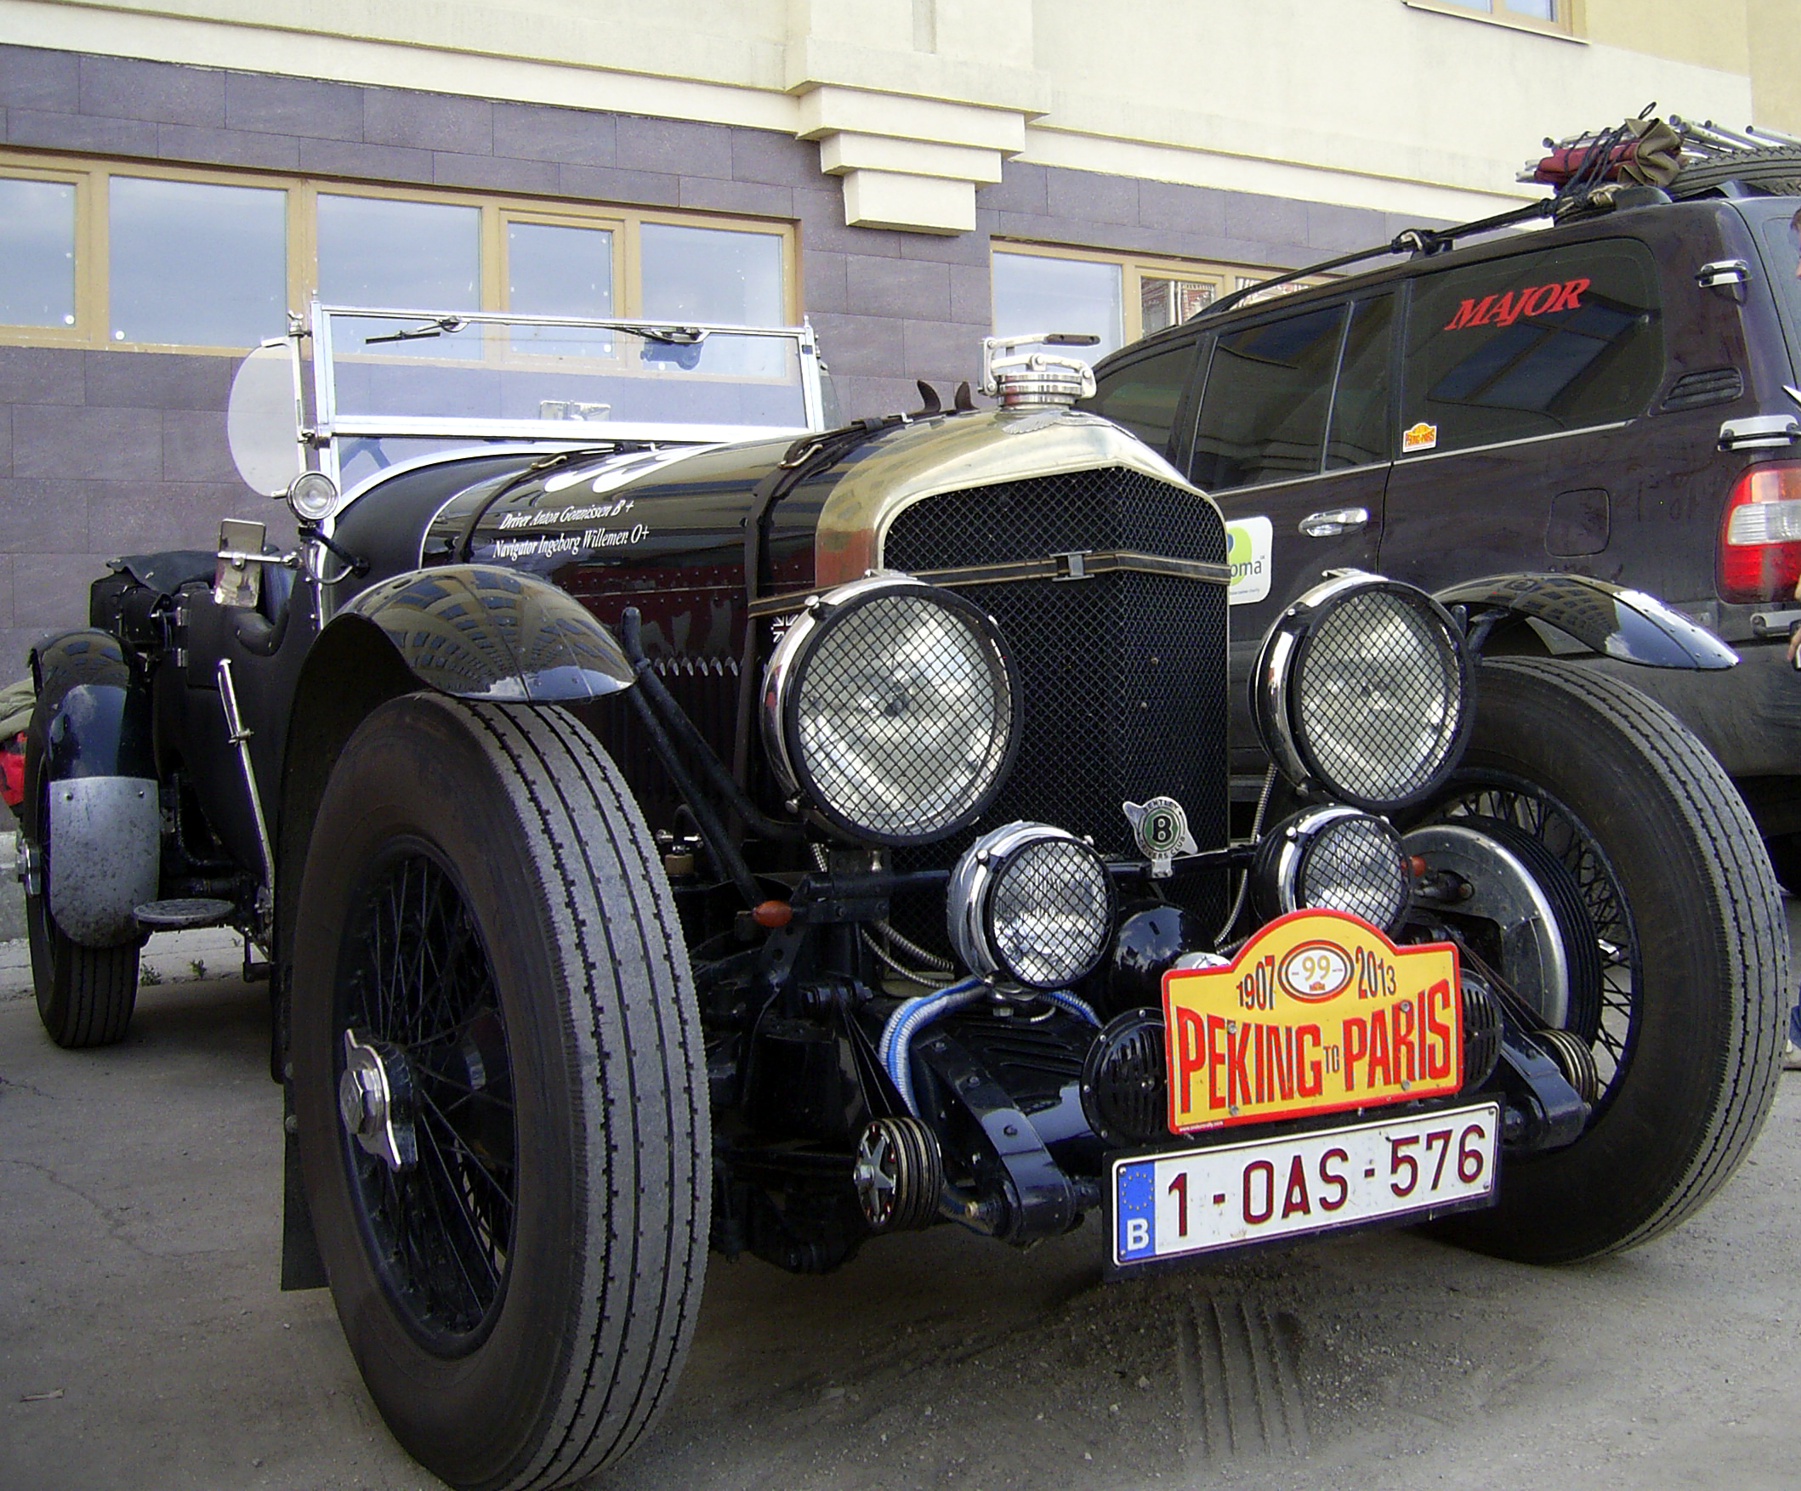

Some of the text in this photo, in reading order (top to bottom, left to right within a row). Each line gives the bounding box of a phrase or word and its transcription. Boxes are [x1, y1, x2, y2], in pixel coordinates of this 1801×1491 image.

[1444, 278, 1591, 331] MAJOR
[499, 512, 532, 530] Driver
[493, 538, 538, 562] Navigator
[538, 532, 580, 558] Ingeborg
[630, 523, 650, 544] O+
[1143, 799, 1178, 813] BENTLEY
[1153, 815, 1173, 843] B
[1170, 836, 1186, 856] CLUB
[1236, 945, 1397, 1010] 1907 99 2013
[1176, 978, 1451, 1114] PEKING TO PARIS
[1168, 1124, 1486, 1238] 1-OAS-576
[1126, 1218, 1150, 1251] B
